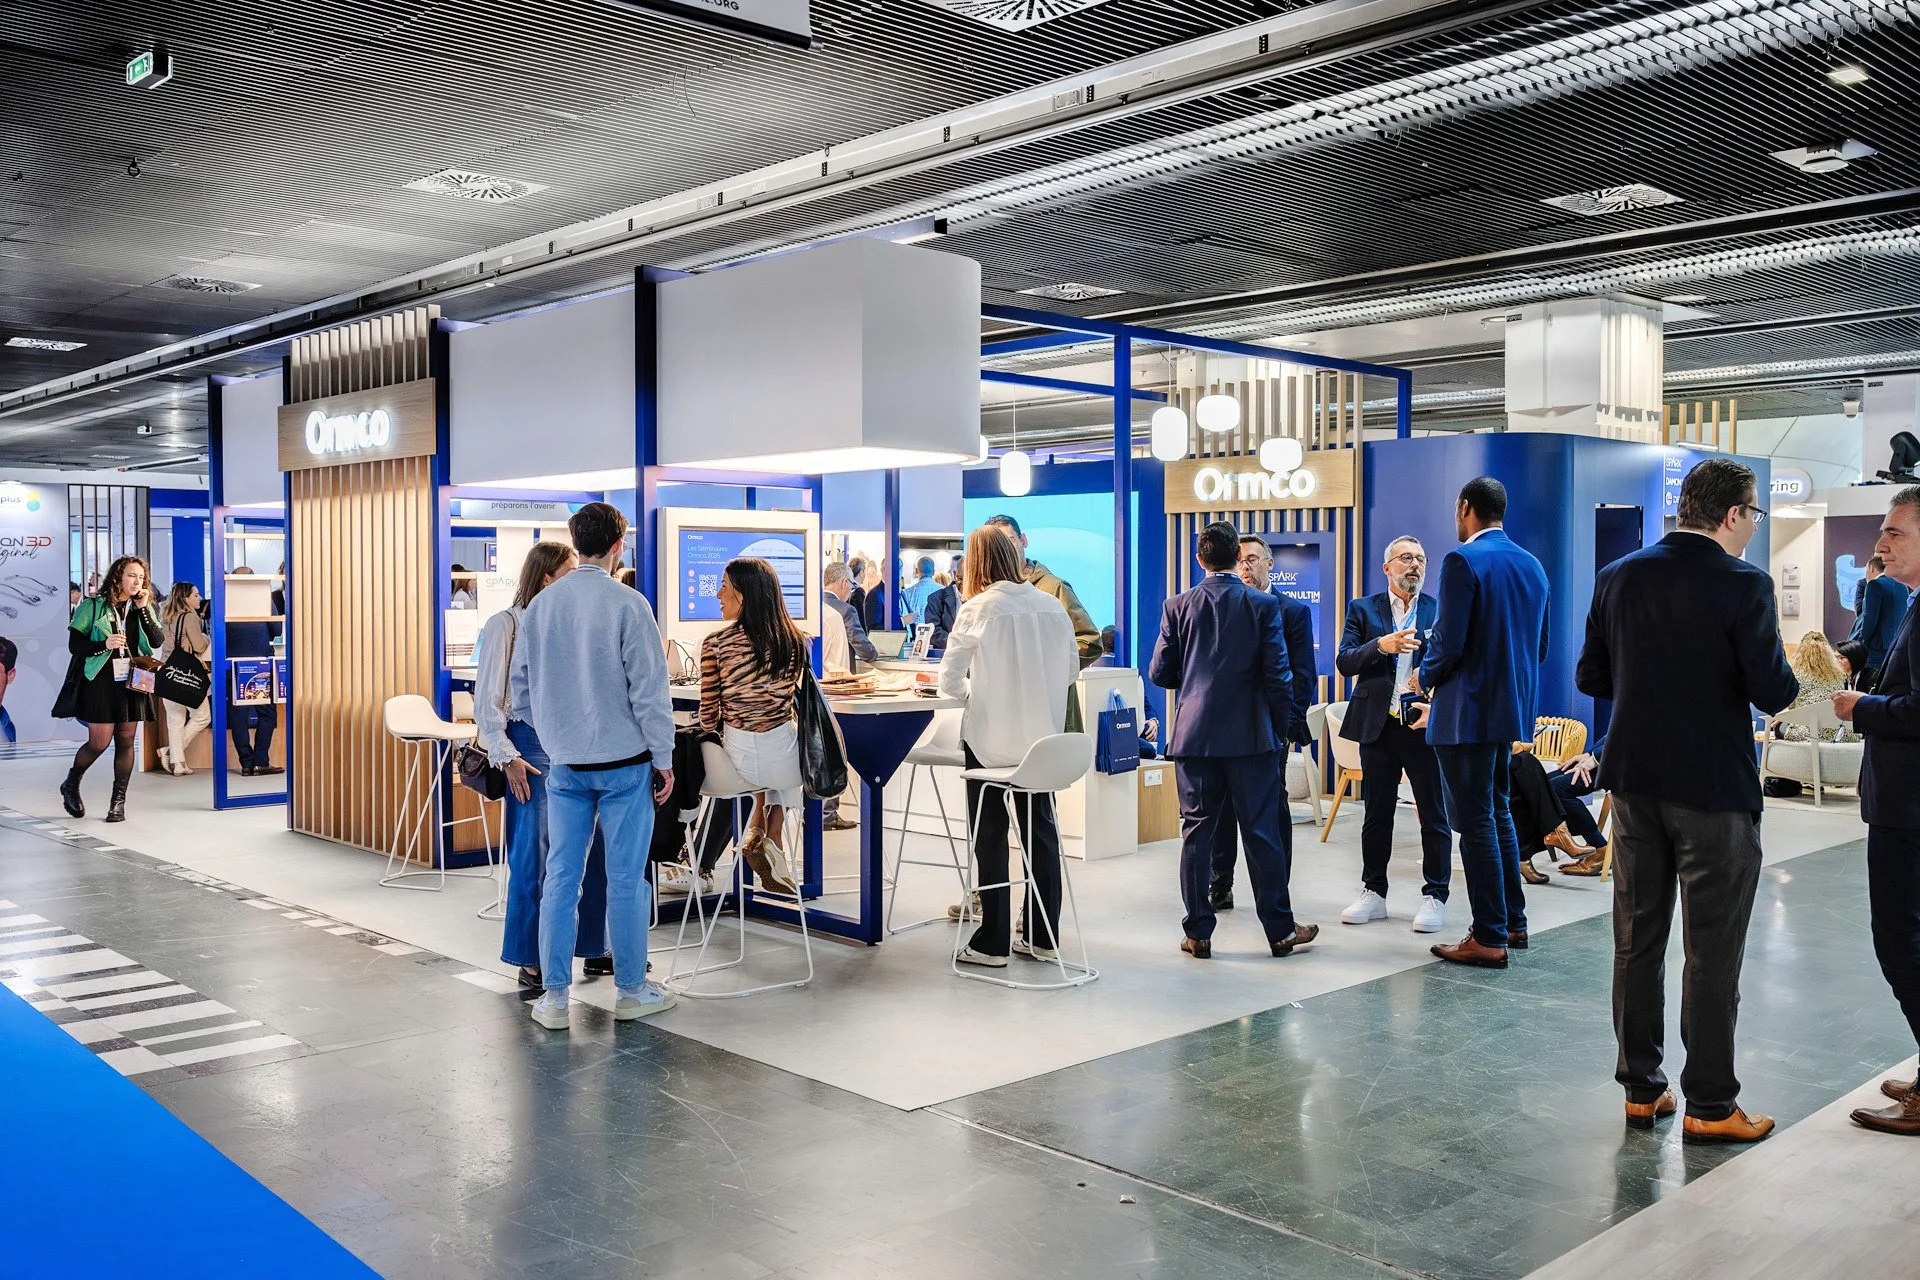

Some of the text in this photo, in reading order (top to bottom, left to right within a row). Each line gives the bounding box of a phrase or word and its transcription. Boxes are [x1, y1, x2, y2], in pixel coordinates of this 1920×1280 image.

[306, 411, 390, 454] Ormco
[1194, 467, 1315, 501] Ormco
[1770, 481, 1799, 493] ring
[1268, 570, 1297, 581] SPARK
[1298, 591, 1320, 599] ULTIM
